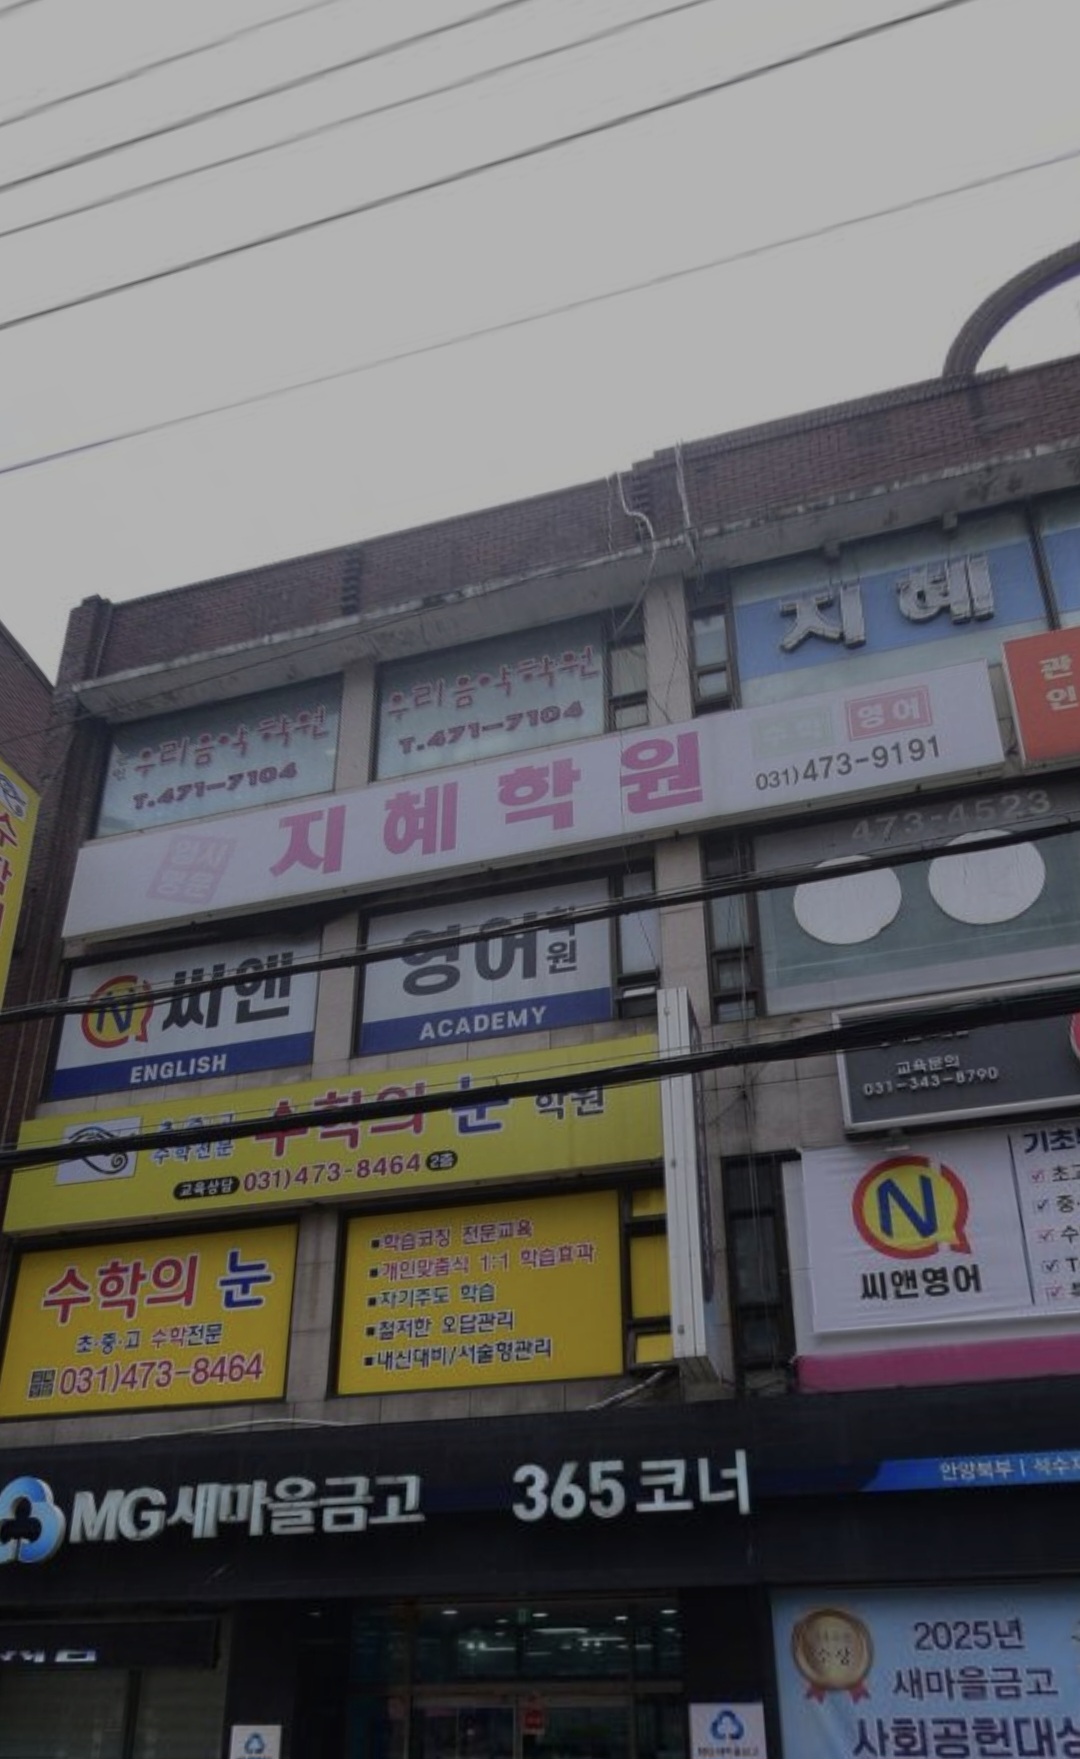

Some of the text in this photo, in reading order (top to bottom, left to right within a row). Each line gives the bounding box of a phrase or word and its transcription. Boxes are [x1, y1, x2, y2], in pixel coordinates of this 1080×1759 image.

[779, 553, 994, 651] 지혜
[857, 697, 922, 730] 영어
[755, 735, 940, 791] 031)473-9191
[270, 730, 703, 877] 지혜학원
[852, 789, 1051, 842] 473-4523
[162, 952, 293, 1031] 씨앤
[419, 1006, 548, 1041] ACADEMY
[130, 1053, 227, 1084] ENGLISH
[895, 1054, 961, 1076] 교육문의
[1024, 1128, 1080, 1153] 기초
[244, 1153, 421, 1193] 031)473-8464
[463, 1219, 532, 1245] 전문교육
[381, 1244, 595, 1281] 개인맞춤식 1:1 학습효과
[43, 1251, 272, 1324] 수학의 눈
[380, 1283, 496, 1308] 자기주도 학습
[861, 1264, 982, 1301] 씨앤영어
[151, 1323, 222, 1348] 수학전문
[442, 1311, 514, 1335] 오답관리
[60, 1352, 262, 1395] 031)473-8464
[512, 1459, 627, 1523] 365
[635, 1448, 753, 1516] 코너
[914, 1617, 1026, 1651] 2025년
[893, 1666, 1059, 1700] 새마을금고
